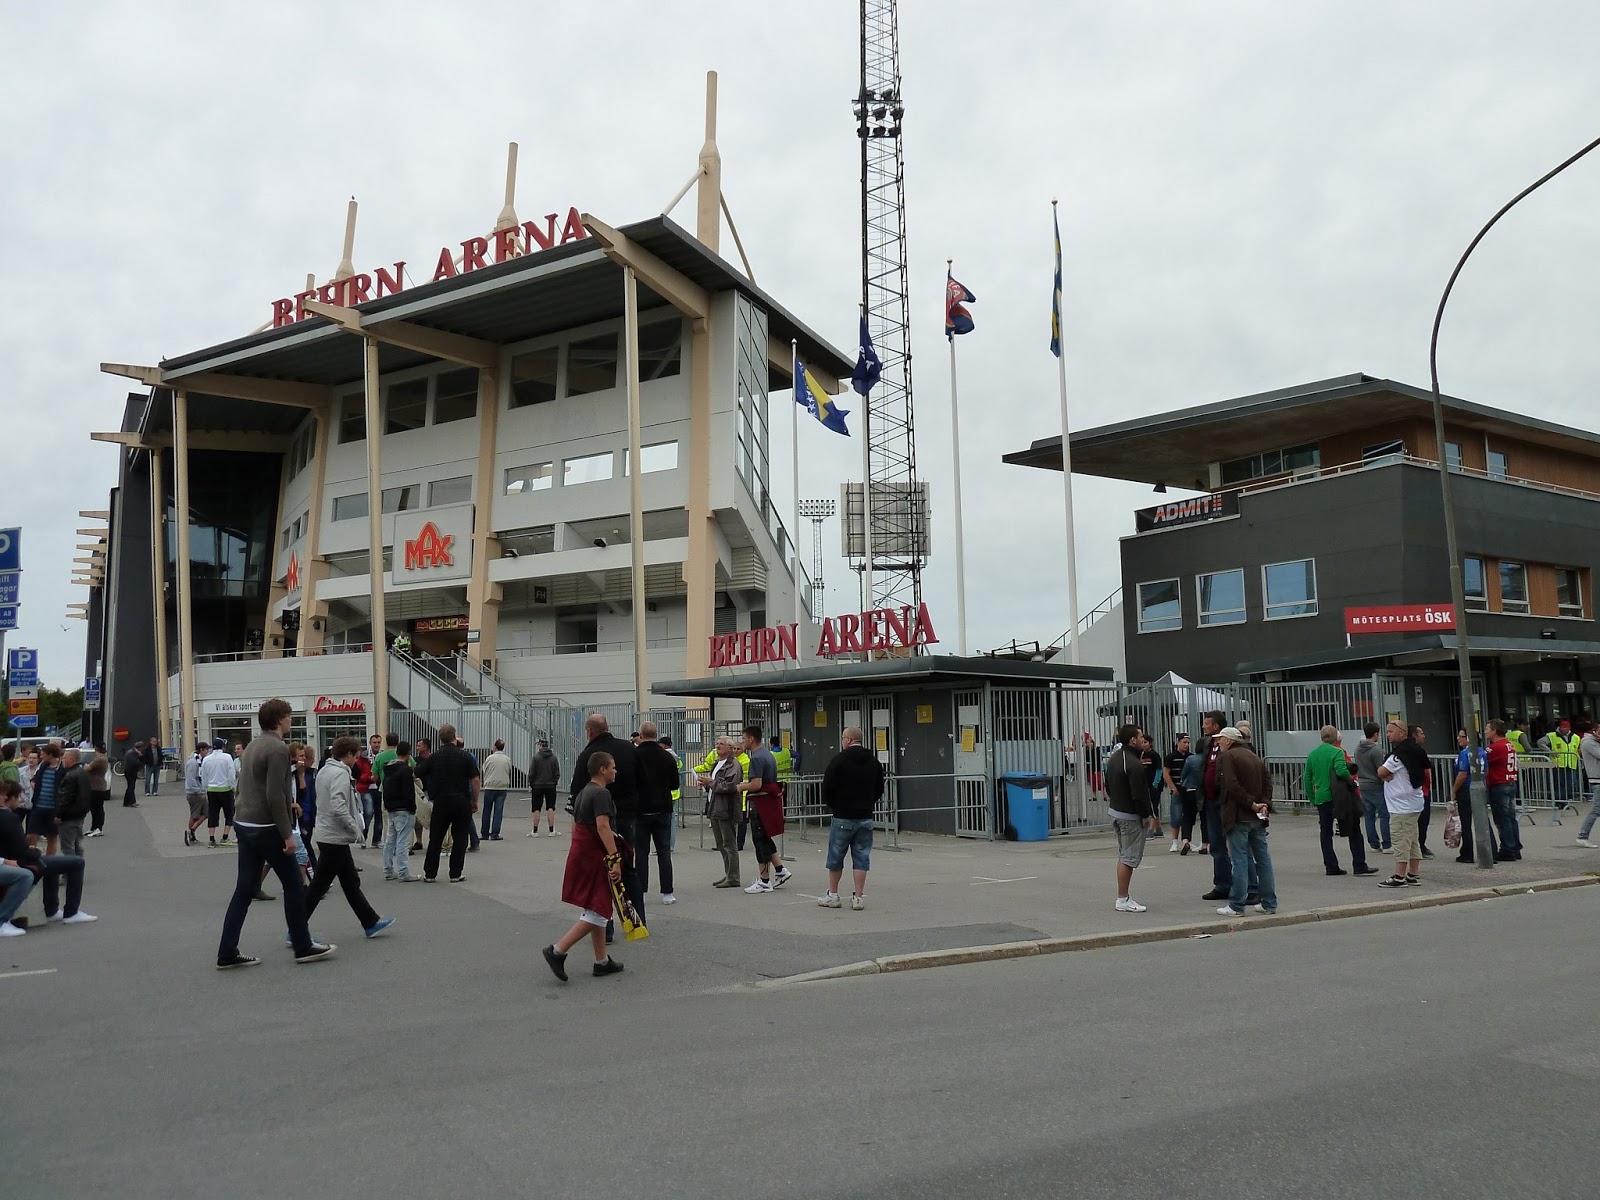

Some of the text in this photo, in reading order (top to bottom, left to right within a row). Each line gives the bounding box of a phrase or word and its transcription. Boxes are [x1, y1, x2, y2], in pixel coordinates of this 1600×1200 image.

[271, 206, 587, 328] BEHRN ARENA
[1153, 495, 1212, 523] ADMIT
[404, 521, 455, 570] MAX
[536, 590, 546, 599] FH
[1352, 607, 1452, 624] MÖTESPLATS ÖSK
[708, 602, 940, 668] BEHRN ARENA
[18, 651, 32, 669] P
[89, 679, 97, 690] P
[239, 703, 252, 711] sport
